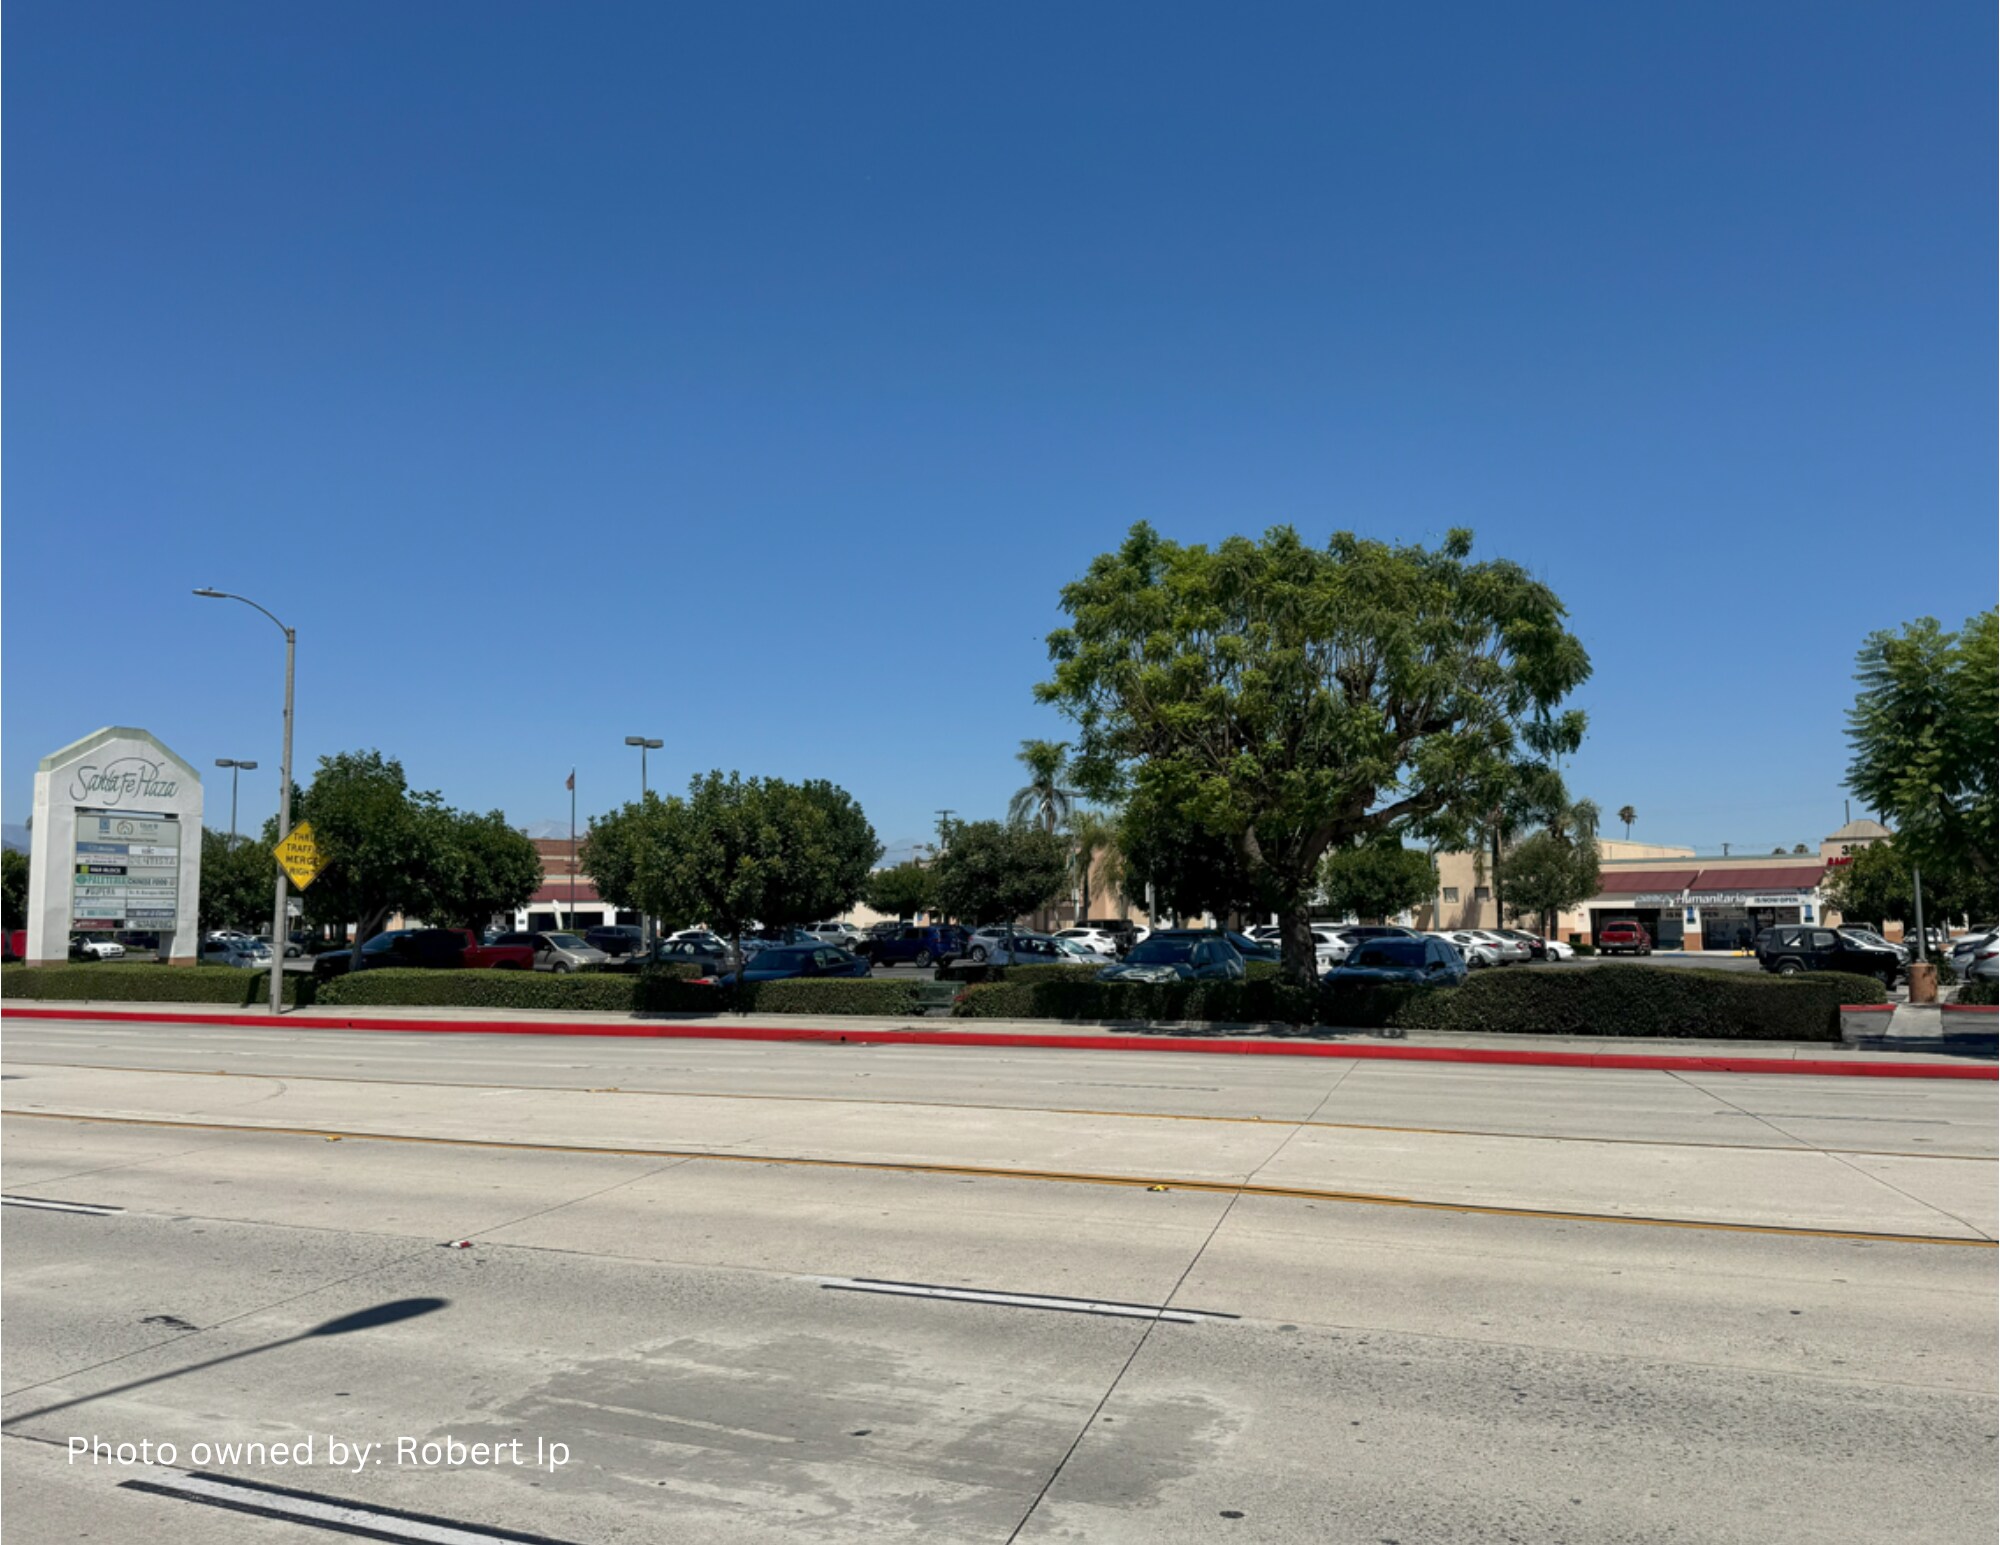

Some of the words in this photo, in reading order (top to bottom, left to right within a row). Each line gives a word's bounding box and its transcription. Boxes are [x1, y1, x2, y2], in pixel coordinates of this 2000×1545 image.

[70, 766, 120, 801] Santa
[120, 757, 179, 798] Plaza
[287, 843, 319, 853] TRAFF
[286, 855, 319, 867] MERGE
